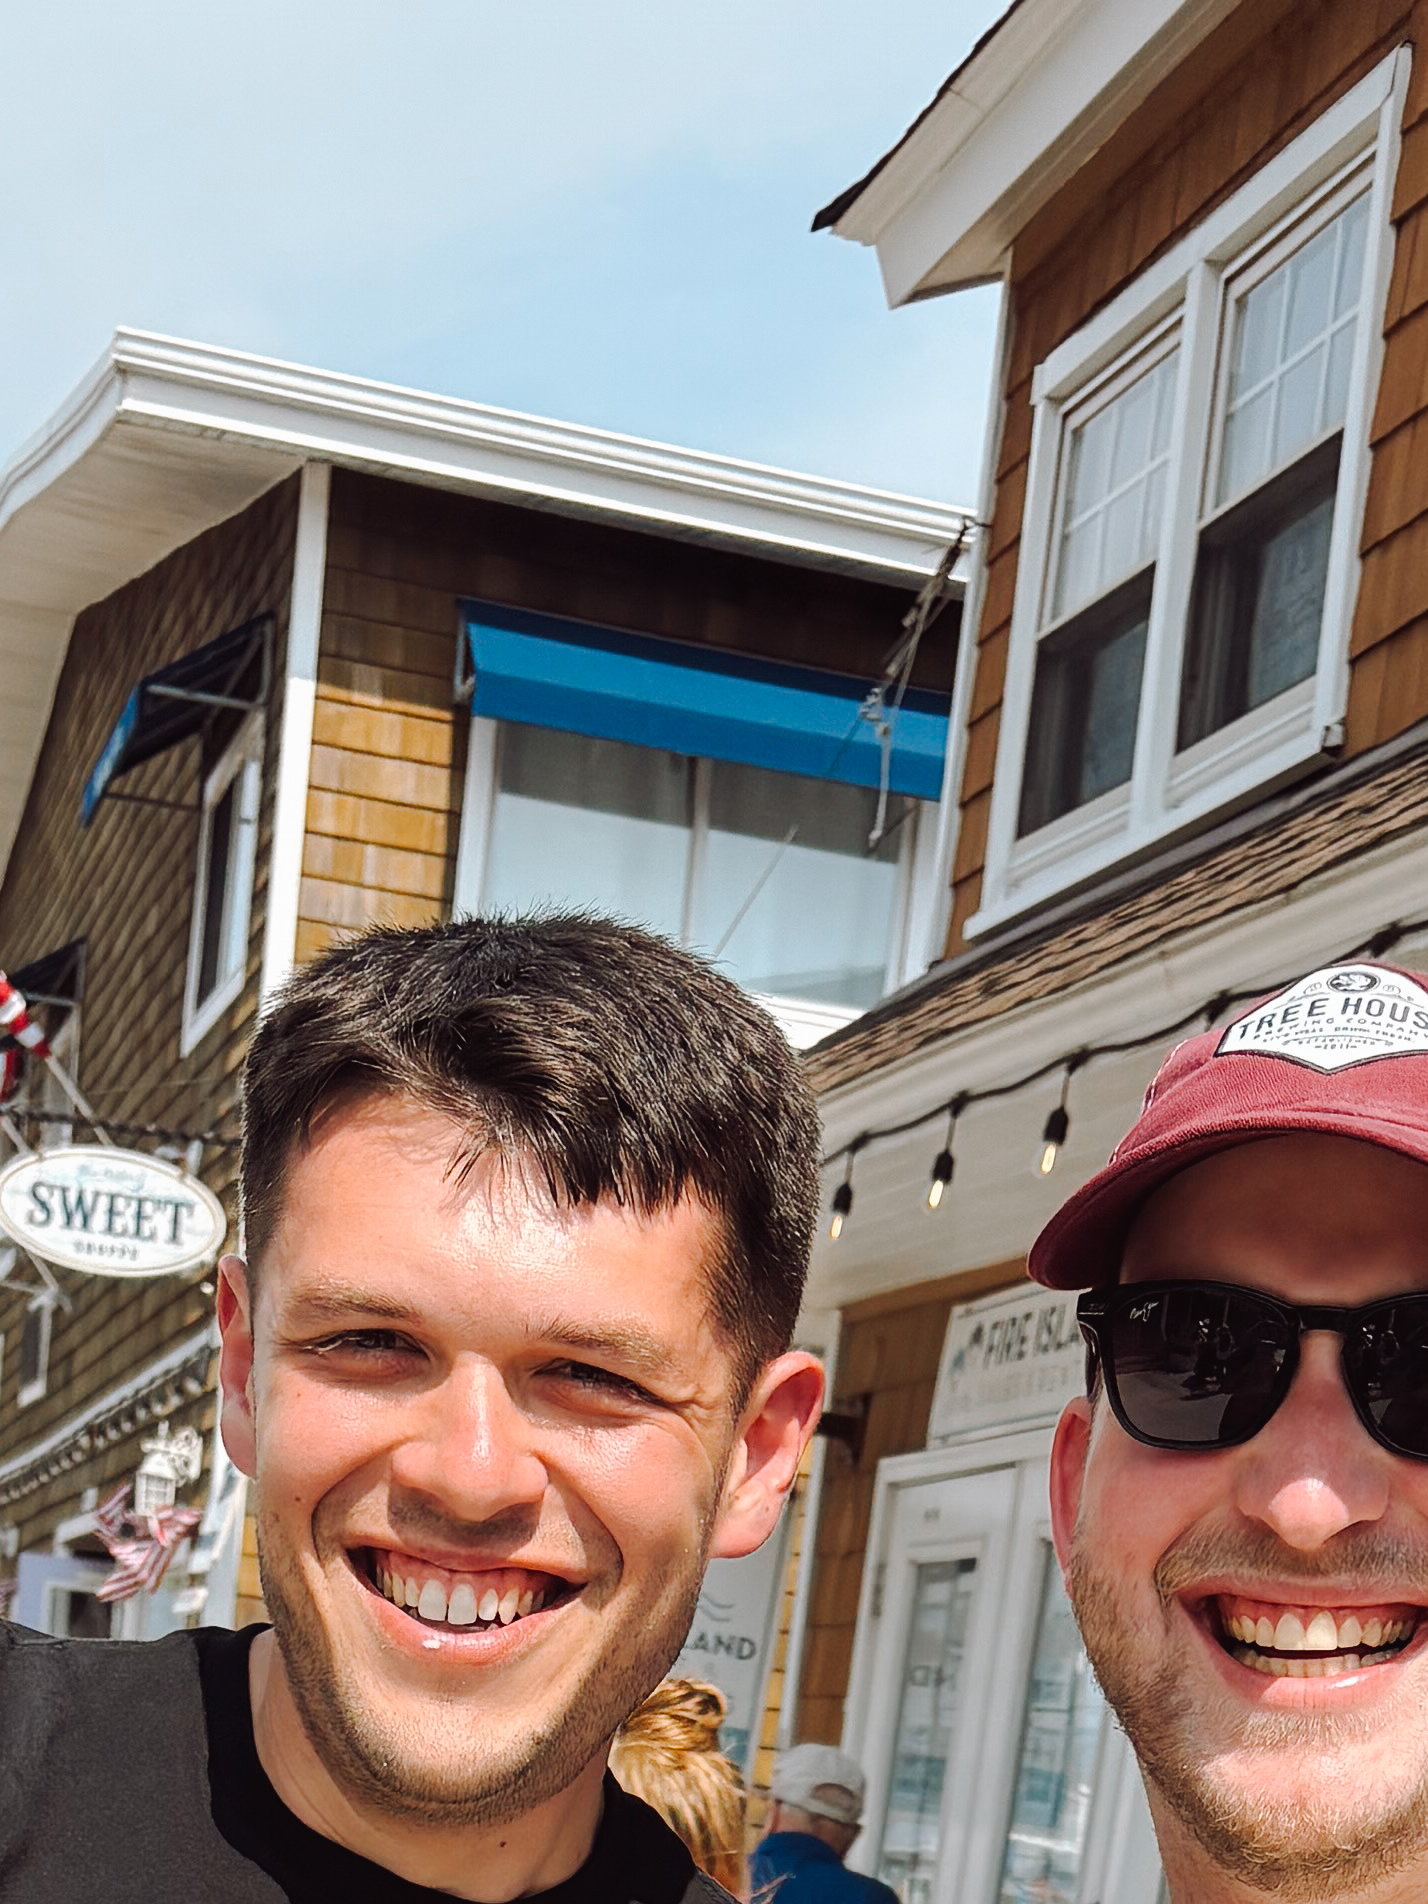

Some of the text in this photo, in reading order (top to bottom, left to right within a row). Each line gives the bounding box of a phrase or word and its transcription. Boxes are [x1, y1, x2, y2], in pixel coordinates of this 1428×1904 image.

[1238, 996, 1330, 1041] TREE
[25, 1179, 195, 1246] SWEET
[982, 1311, 1033, 1370] FIRE
[685, 1630, 757, 1661] AND
